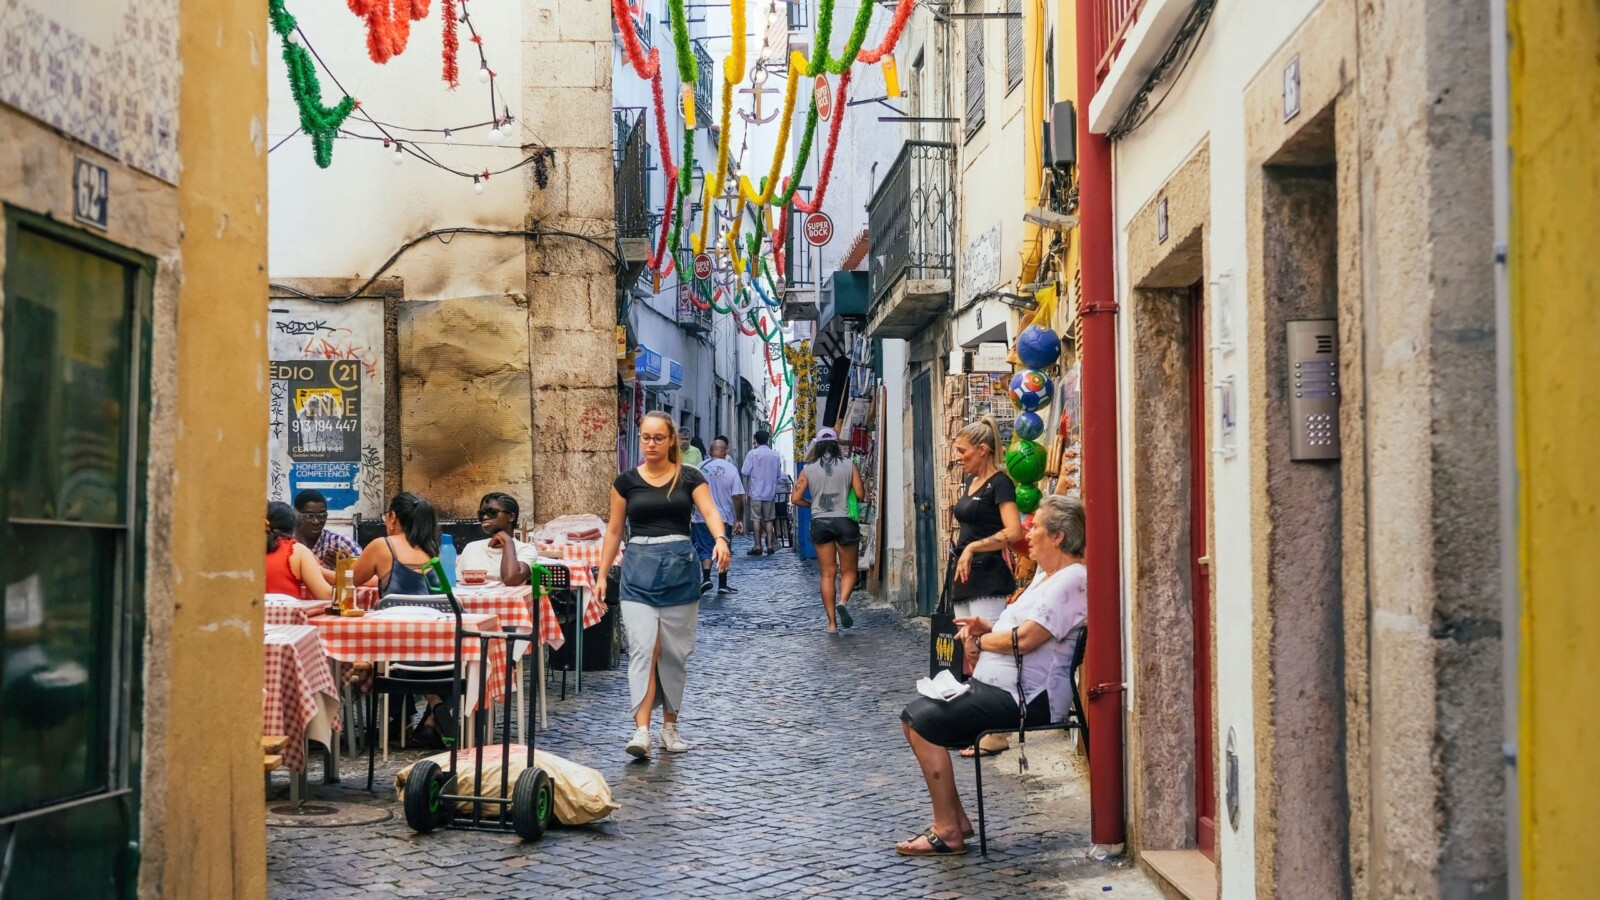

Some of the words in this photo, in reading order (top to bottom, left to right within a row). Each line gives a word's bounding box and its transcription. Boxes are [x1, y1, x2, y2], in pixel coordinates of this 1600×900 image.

[807, 222, 829, 230] SUPER
[809, 229, 829, 237] BOCK
[292, 419, 311, 432] 913
[314, 419, 332, 432] 194
[335, 419, 357, 432] 447
